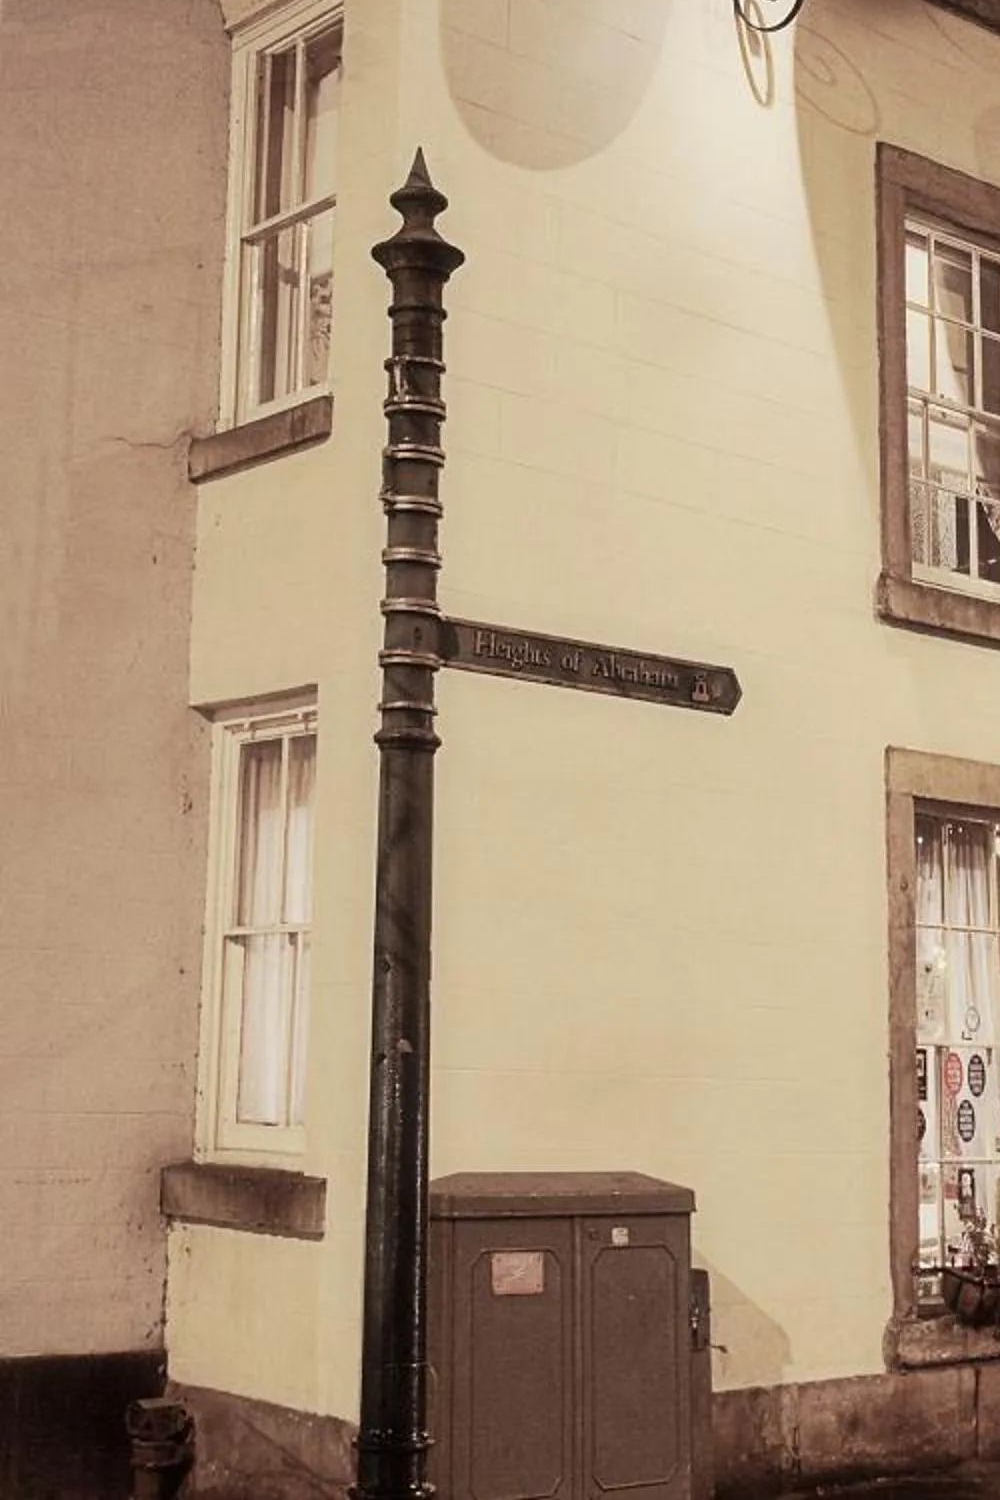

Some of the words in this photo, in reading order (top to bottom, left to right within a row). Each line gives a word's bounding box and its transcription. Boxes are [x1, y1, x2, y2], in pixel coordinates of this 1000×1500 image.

[474, 629, 550, 668] Heights
[560, 649, 584, 672] of
[592, 654, 679, 688] Abraham
